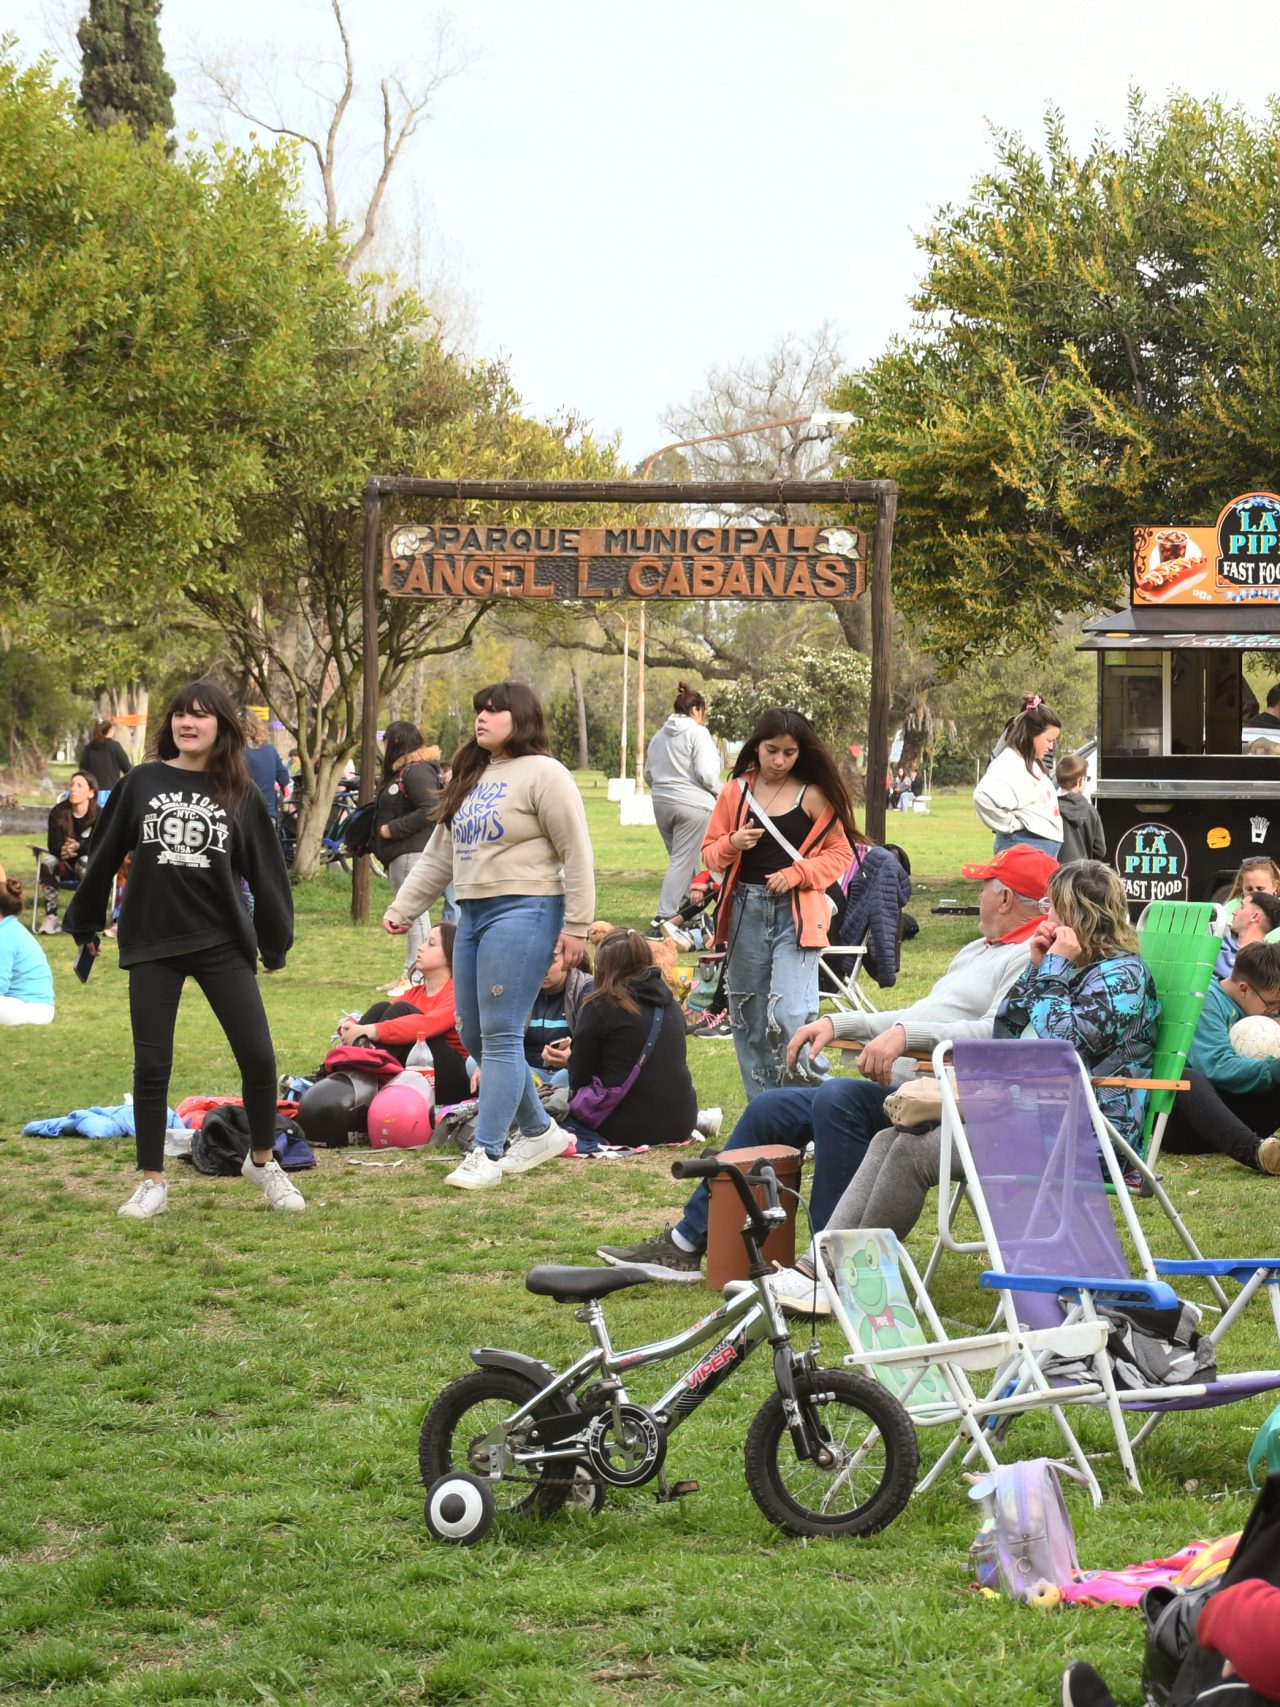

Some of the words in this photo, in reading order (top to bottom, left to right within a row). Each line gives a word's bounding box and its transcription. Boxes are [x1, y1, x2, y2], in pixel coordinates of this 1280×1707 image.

[1240, 512, 1278, 532] LA
[440, 528, 580, 553] PARQUE
[604, 528, 815, 553] MUNICIPAL
[403, 559, 555, 597] ANGEL
[1223, 561, 1255, 584] FAST
[149, 791, 183, 810] NEW
[191, 792, 227, 819] YORK
[176, 810, 196, 820] NYC
[143, 822, 155, 840] N
[163, 817, 205, 848] 96
[217, 831, 228, 848] Y
[174, 845, 192, 853] USA
[1134, 836, 1168, 855] LA
[1124, 855, 1178, 875] PIPI
[1151, 880, 1183, 900] FOOD
[684, 1346, 738, 1389] VIPER
